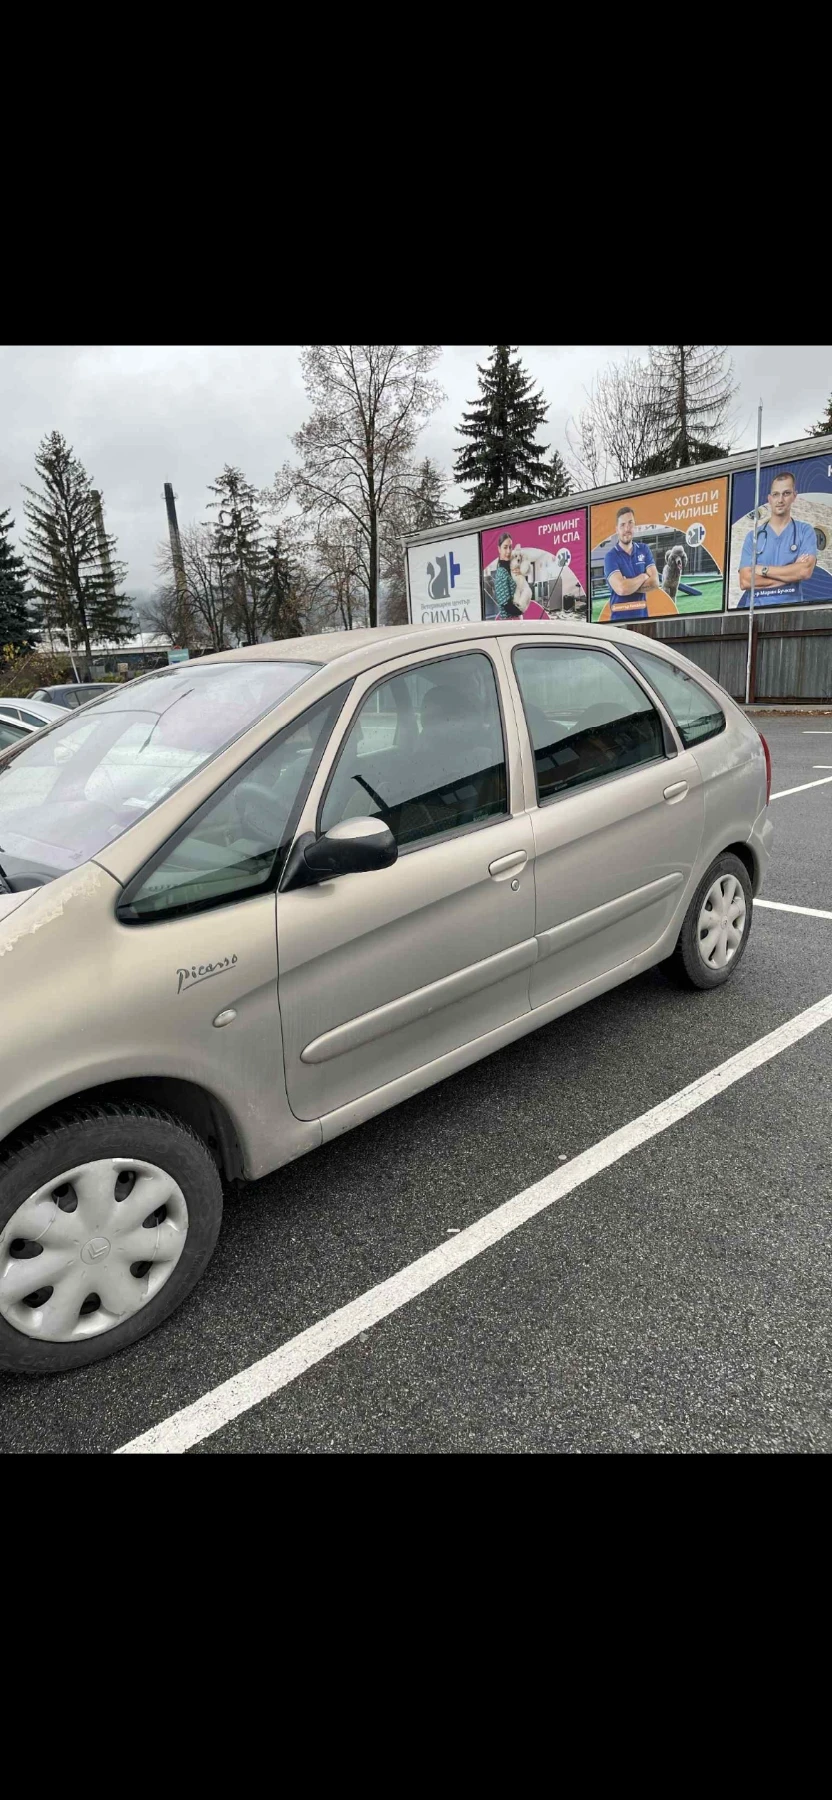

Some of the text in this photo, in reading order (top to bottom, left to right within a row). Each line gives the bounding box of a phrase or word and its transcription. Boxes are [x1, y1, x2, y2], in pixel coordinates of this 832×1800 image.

[674, 489, 719, 508] ХОТЕЛ И
[663, 502, 719, 523] УЧИЛИЩЕ
[537, 517, 580, 536] ГРУМИНГ
[553, 530, 580, 545] И СПА
[421, 607, 471, 624] СИМБА
[176, 953, 239, 995] Picasso
